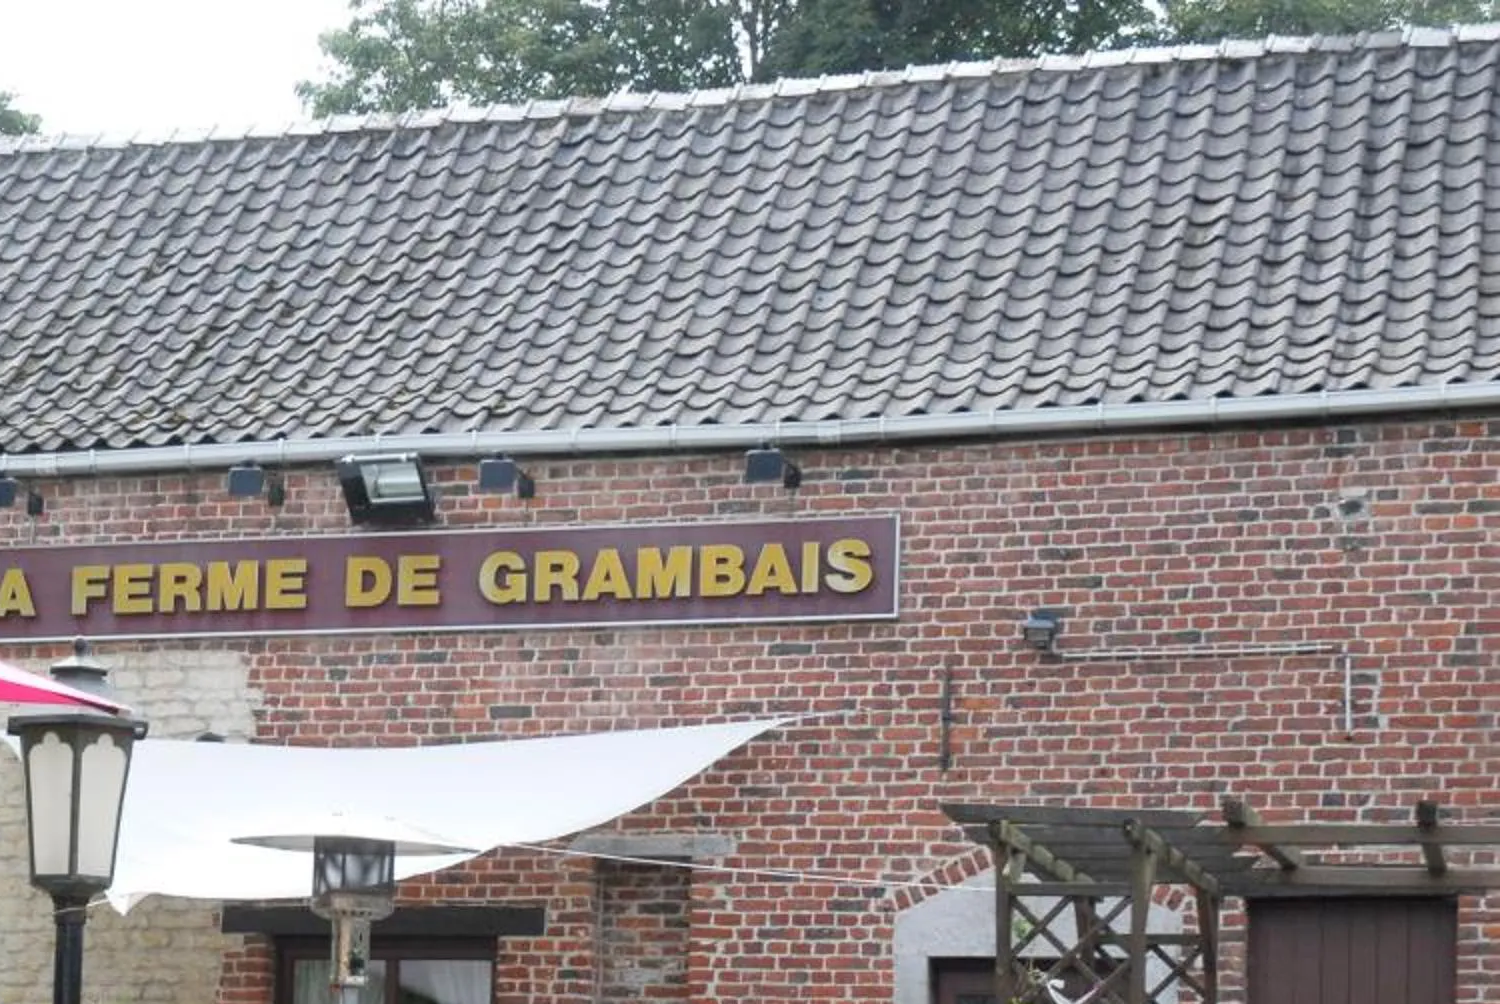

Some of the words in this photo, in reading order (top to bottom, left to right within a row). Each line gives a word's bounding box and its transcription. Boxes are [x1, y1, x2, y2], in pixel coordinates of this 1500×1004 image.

[71, 557, 308, 614] FERME
[344, 554, 442, 607] DE
[479, 537, 873, 604] GRAMBAIS
